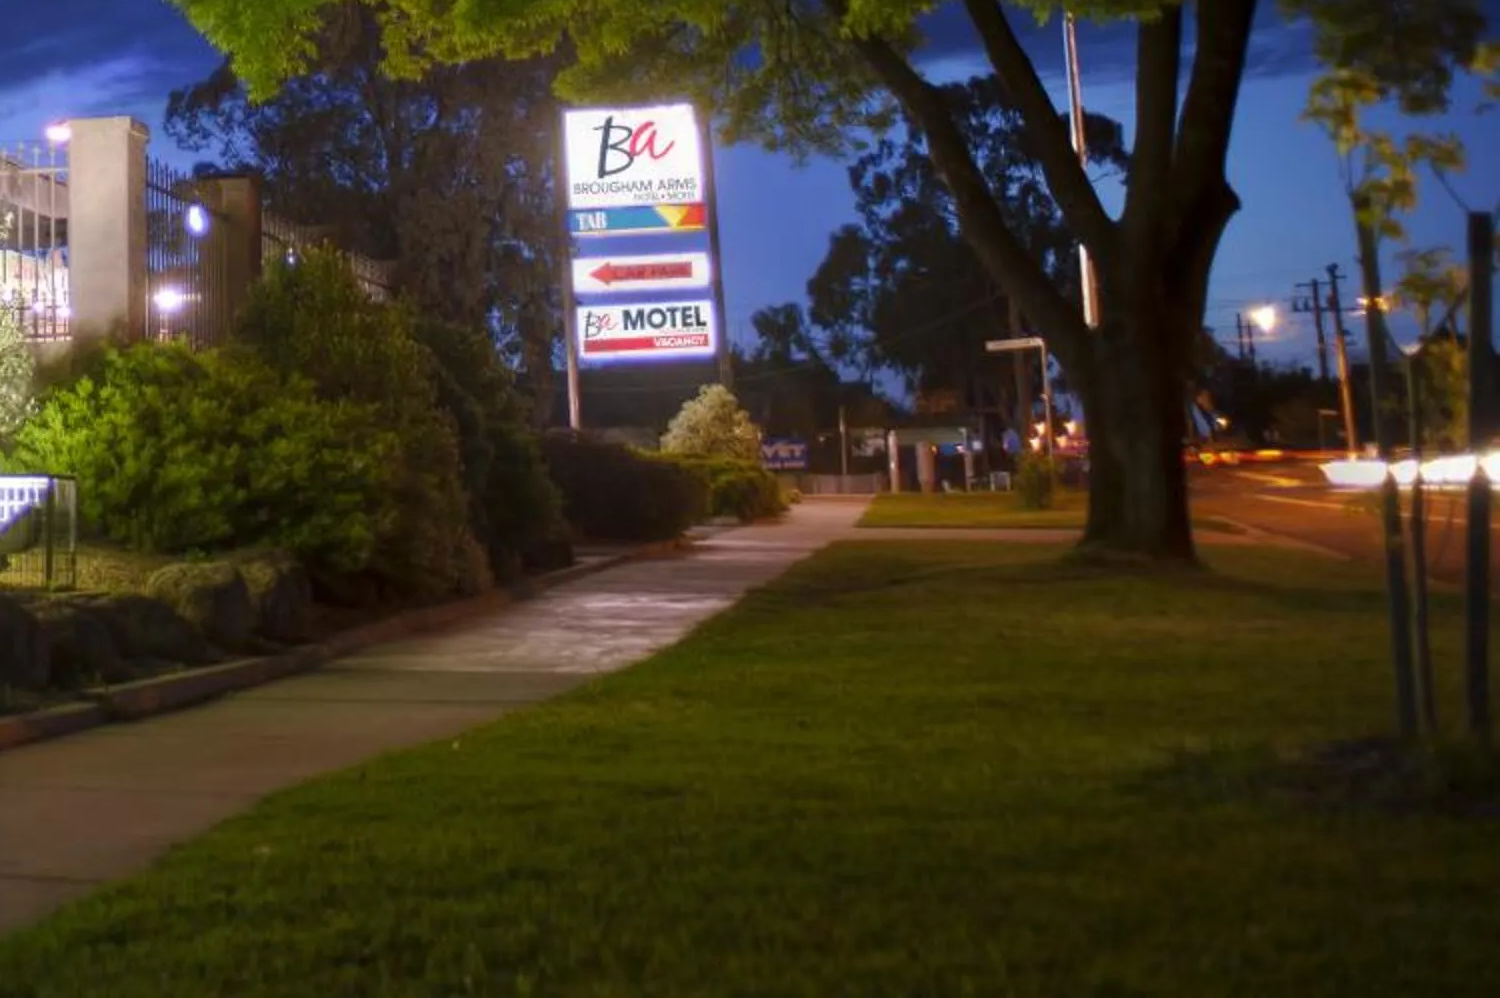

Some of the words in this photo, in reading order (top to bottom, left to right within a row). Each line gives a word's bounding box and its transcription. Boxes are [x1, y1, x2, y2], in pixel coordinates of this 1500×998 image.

[593, 115, 675, 179] Ba
[573, 180, 653, 195] BROUGHAM
[657, 177, 697, 192] ARMS
[577, 212, 608, 231] TAB
[622, 306, 707, 331] MOTEL
[653, 335, 705, 347] VACANCY
